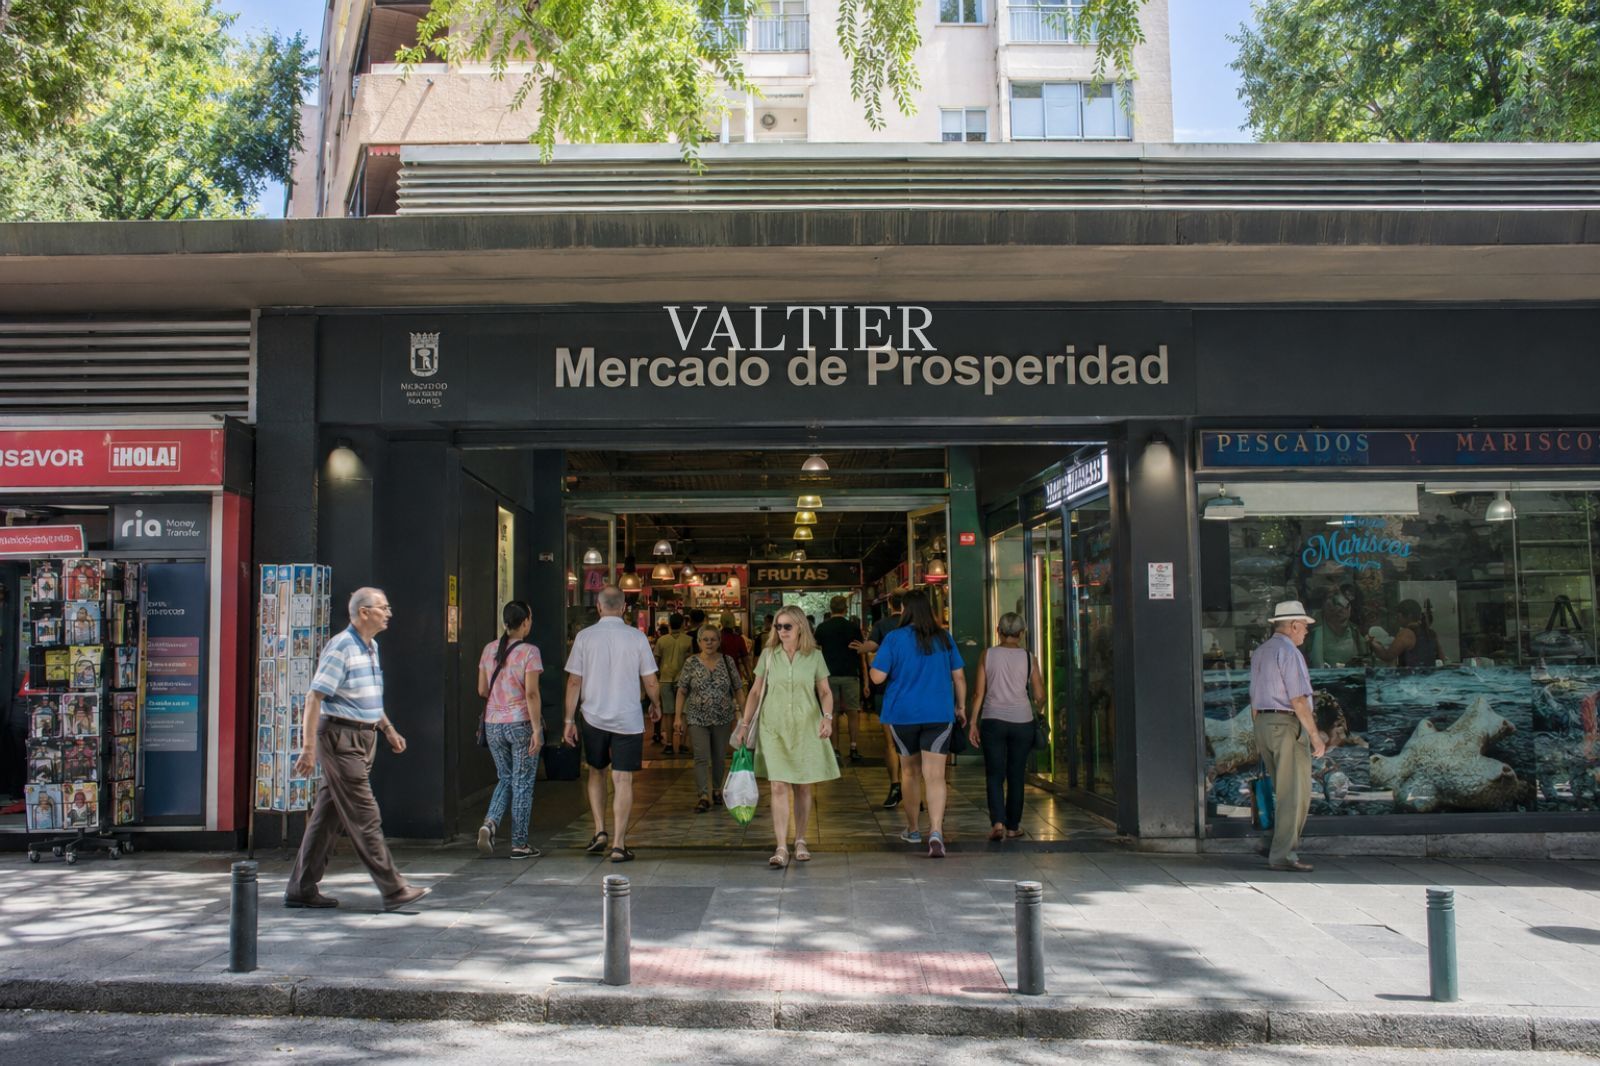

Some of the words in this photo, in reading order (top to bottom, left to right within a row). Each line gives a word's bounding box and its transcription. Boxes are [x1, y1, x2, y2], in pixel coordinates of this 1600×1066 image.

[555, 345, 770, 387] Mercado
[787, 346, 847, 387] de
[867, 345, 1169, 395] Prosperidad
[1217, 434, 1369, 452] PESCADOS
[1405, 433, 1420, 451] Y
[1456, 432, 1600, 451] MARISCO
[113, 447, 177, 466] ¡HOLA!
[122, 510, 162, 537] ria
[166, 520, 196, 528] Money
[166, 529, 200, 537] Transfer
[1302, 530, 1413, 568] Mariscos
[757, 565, 829, 580] FRUTAS
